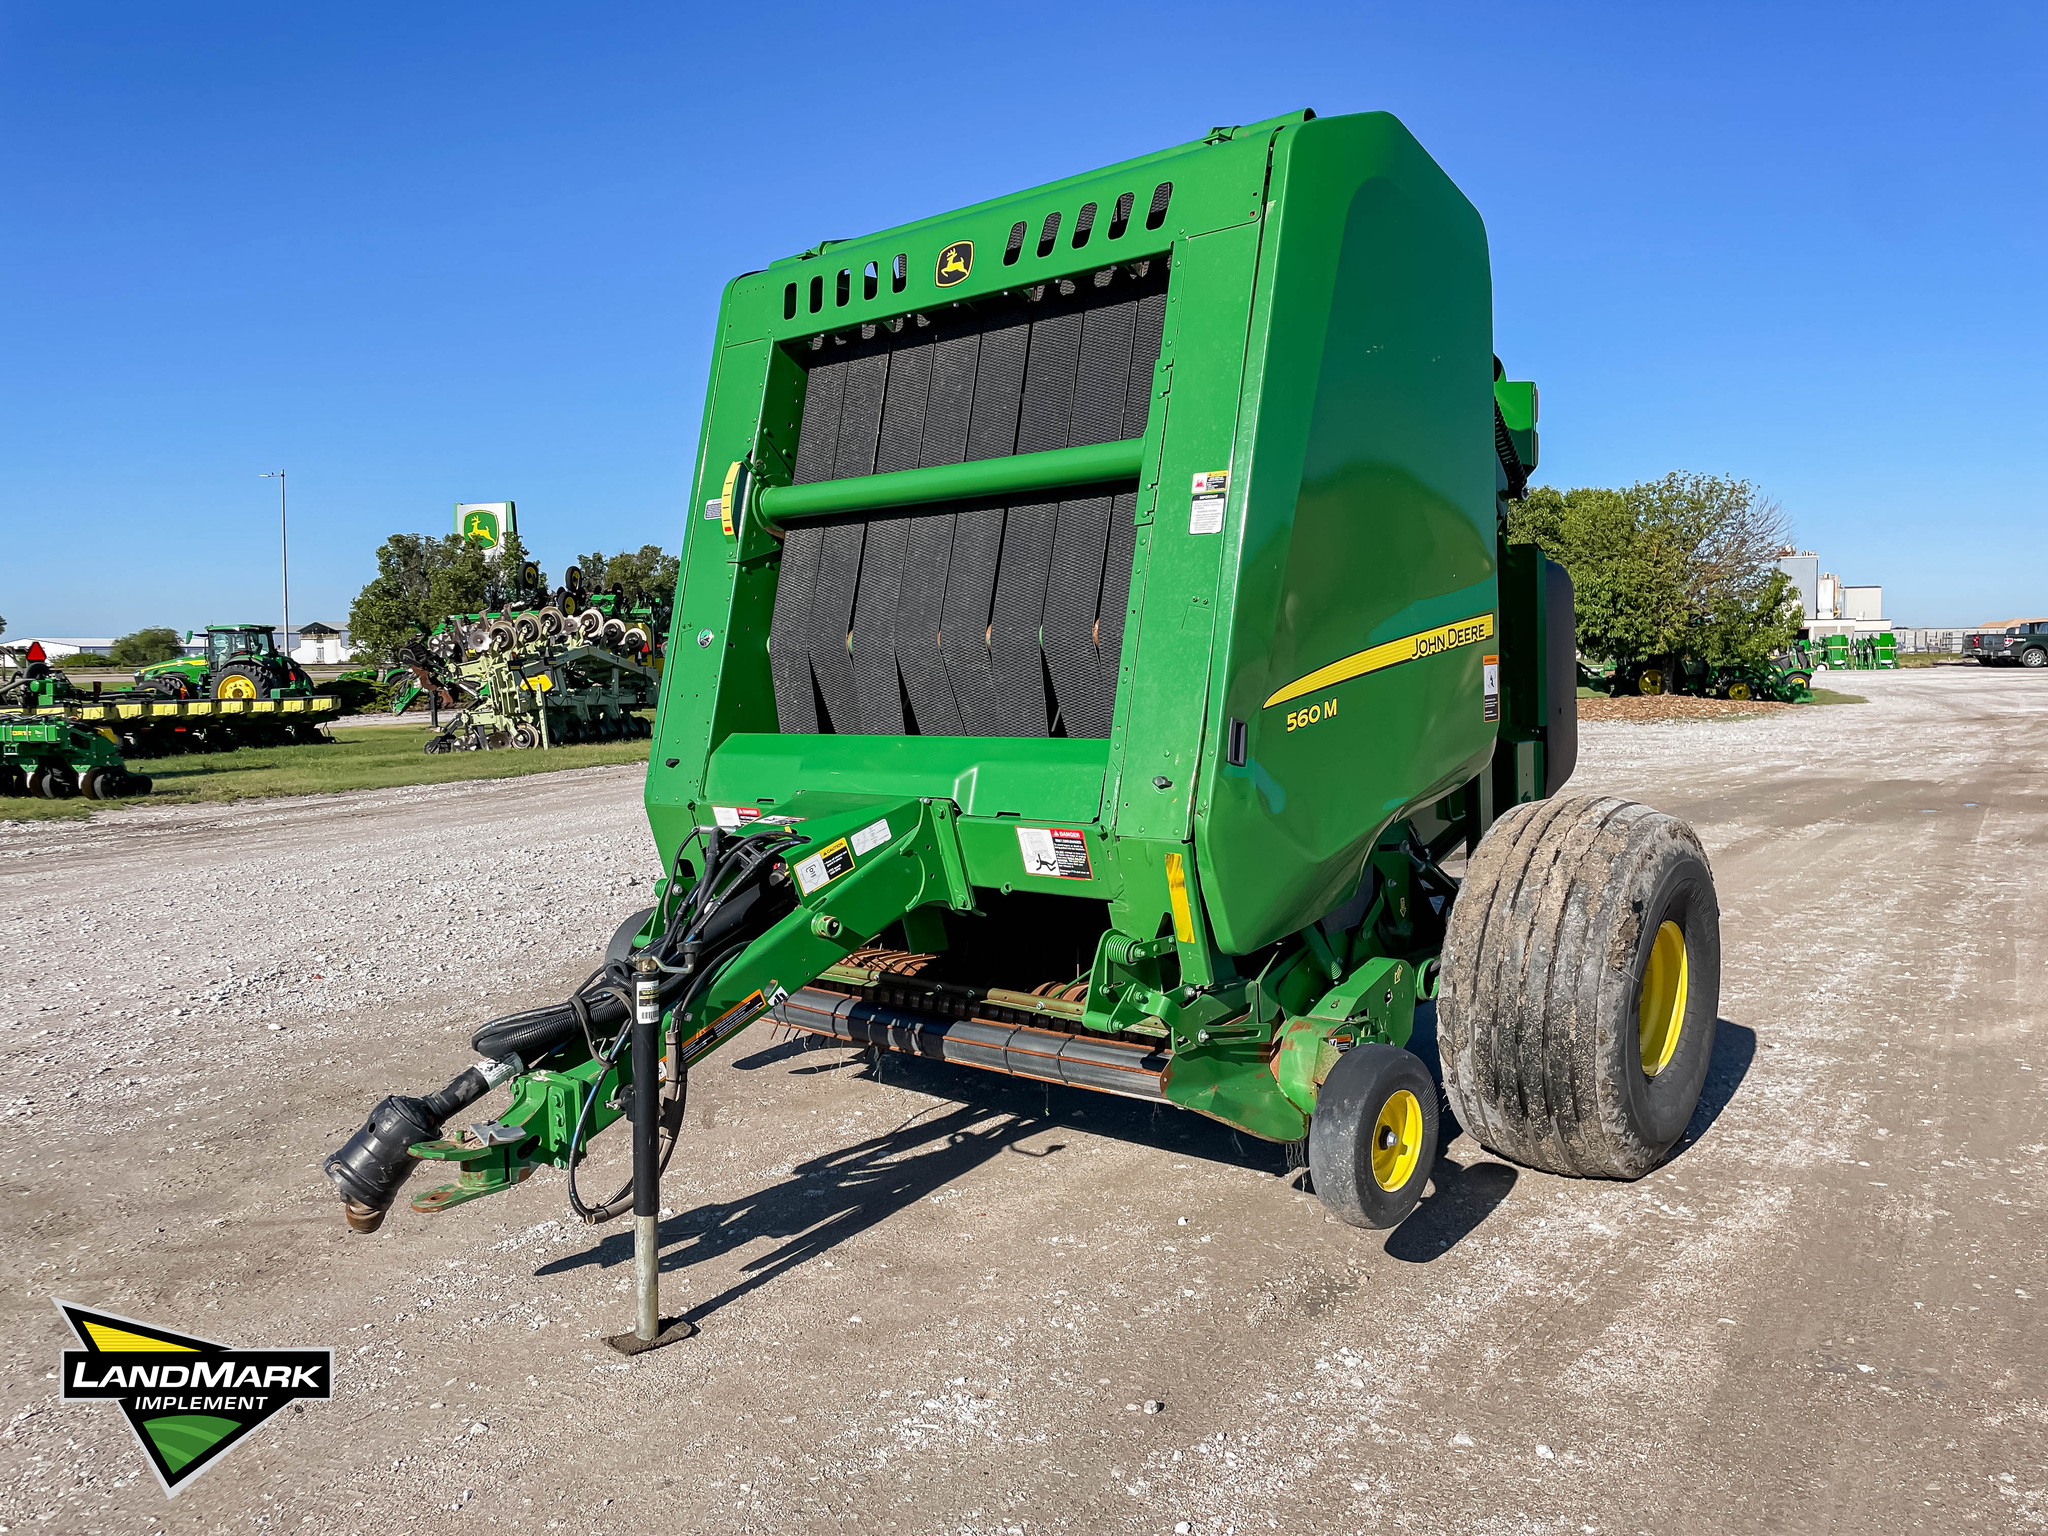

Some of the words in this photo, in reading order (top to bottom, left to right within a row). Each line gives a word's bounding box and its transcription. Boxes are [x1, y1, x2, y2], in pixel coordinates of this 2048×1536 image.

[1411, 634, 1446, 658] JOHN
[1447, 624, 1485, 646] DEERE
[1286, 703, 1322, 733] 560
[1323, 696, 1338, 720] M
[826, 842, 844, 854] CAUTION
